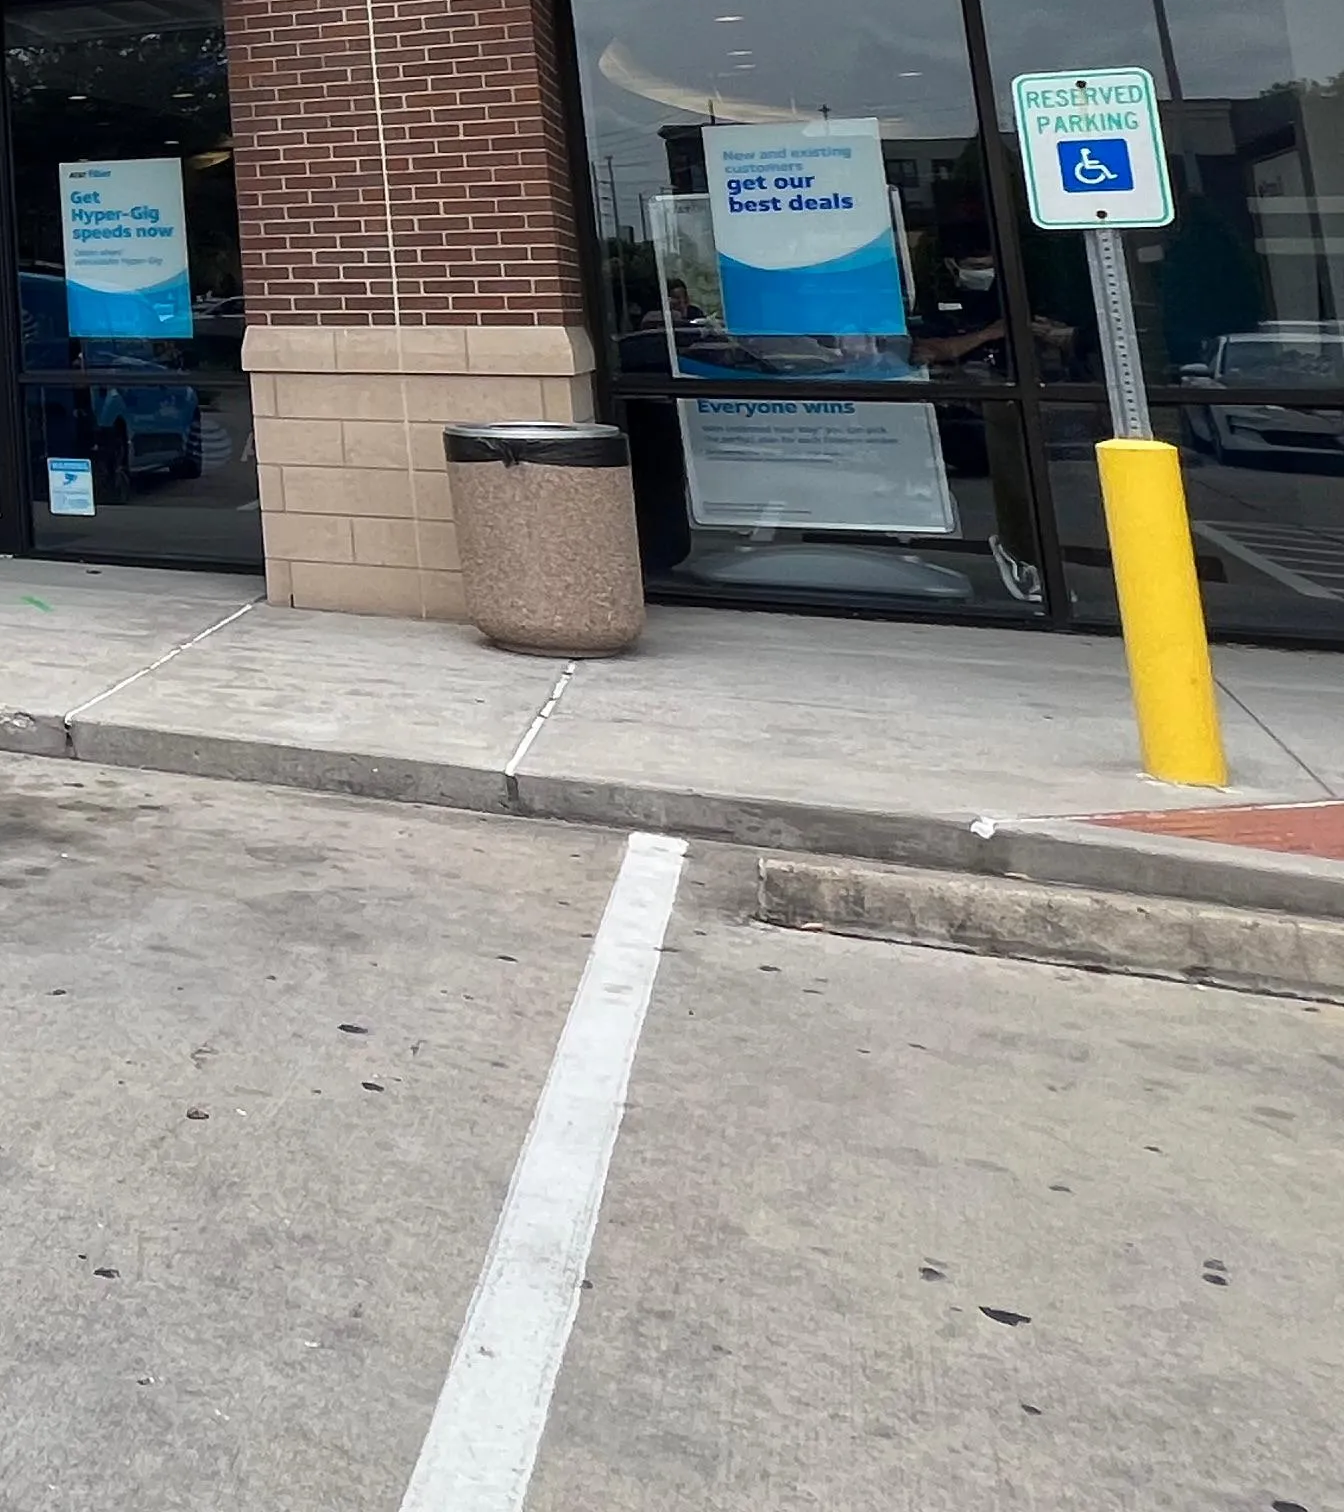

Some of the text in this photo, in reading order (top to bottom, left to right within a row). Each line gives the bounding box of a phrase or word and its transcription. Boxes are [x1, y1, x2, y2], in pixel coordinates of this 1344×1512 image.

[1026, 85, 1143, 109] RESERVED
[1036, 111, 1140, 135] PARKING
[723, 146, 852, 161] New and existing
[724, 162, 804, 174] customers
[726, 174, 815, 196] get our
[70, 191, 101, 204] Get
[728, 193, 854, 213] best deals
[71, 205, 160, 225] Hyper-Gig
[72, 225, 175, 243] speeds now
[697, 399, 856, 418] Everyone wins
